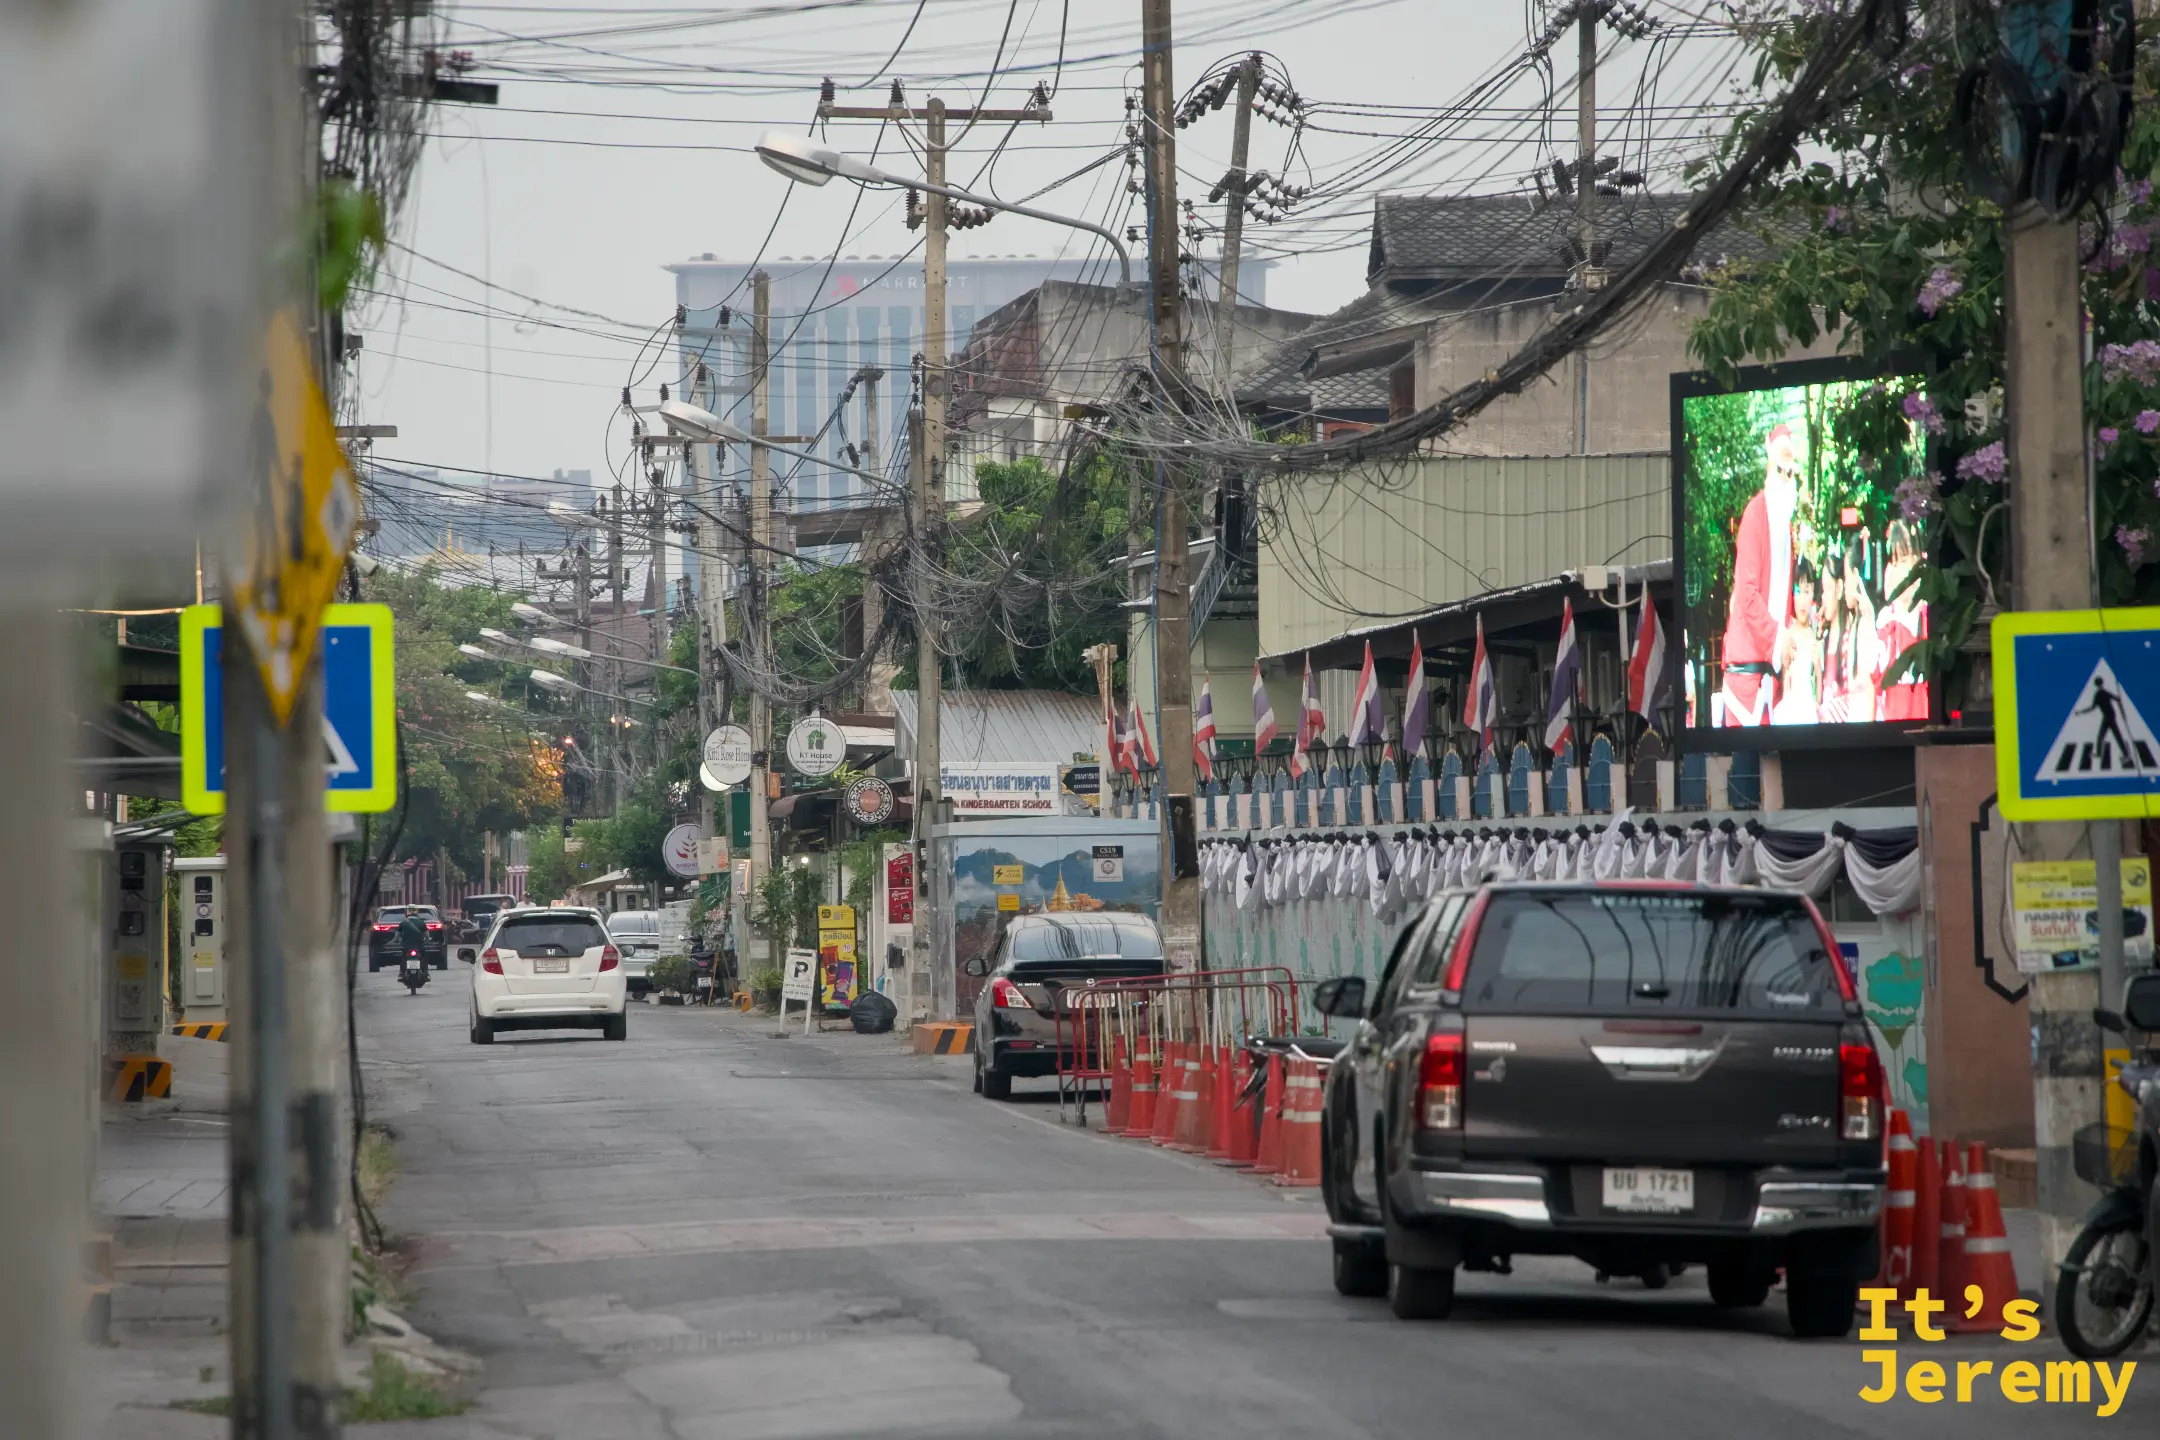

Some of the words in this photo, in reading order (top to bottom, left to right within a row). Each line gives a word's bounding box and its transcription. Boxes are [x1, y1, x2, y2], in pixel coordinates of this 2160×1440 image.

[863, 276, 969, 289] MARRITT
[721, 747, 735, 761] Rose
[961, 799, 1020, 809] KINDERGARTEN
[1022, 799, 1053, 809] SCHOOL
[1649, 1174, 1689, 1192] 1721
